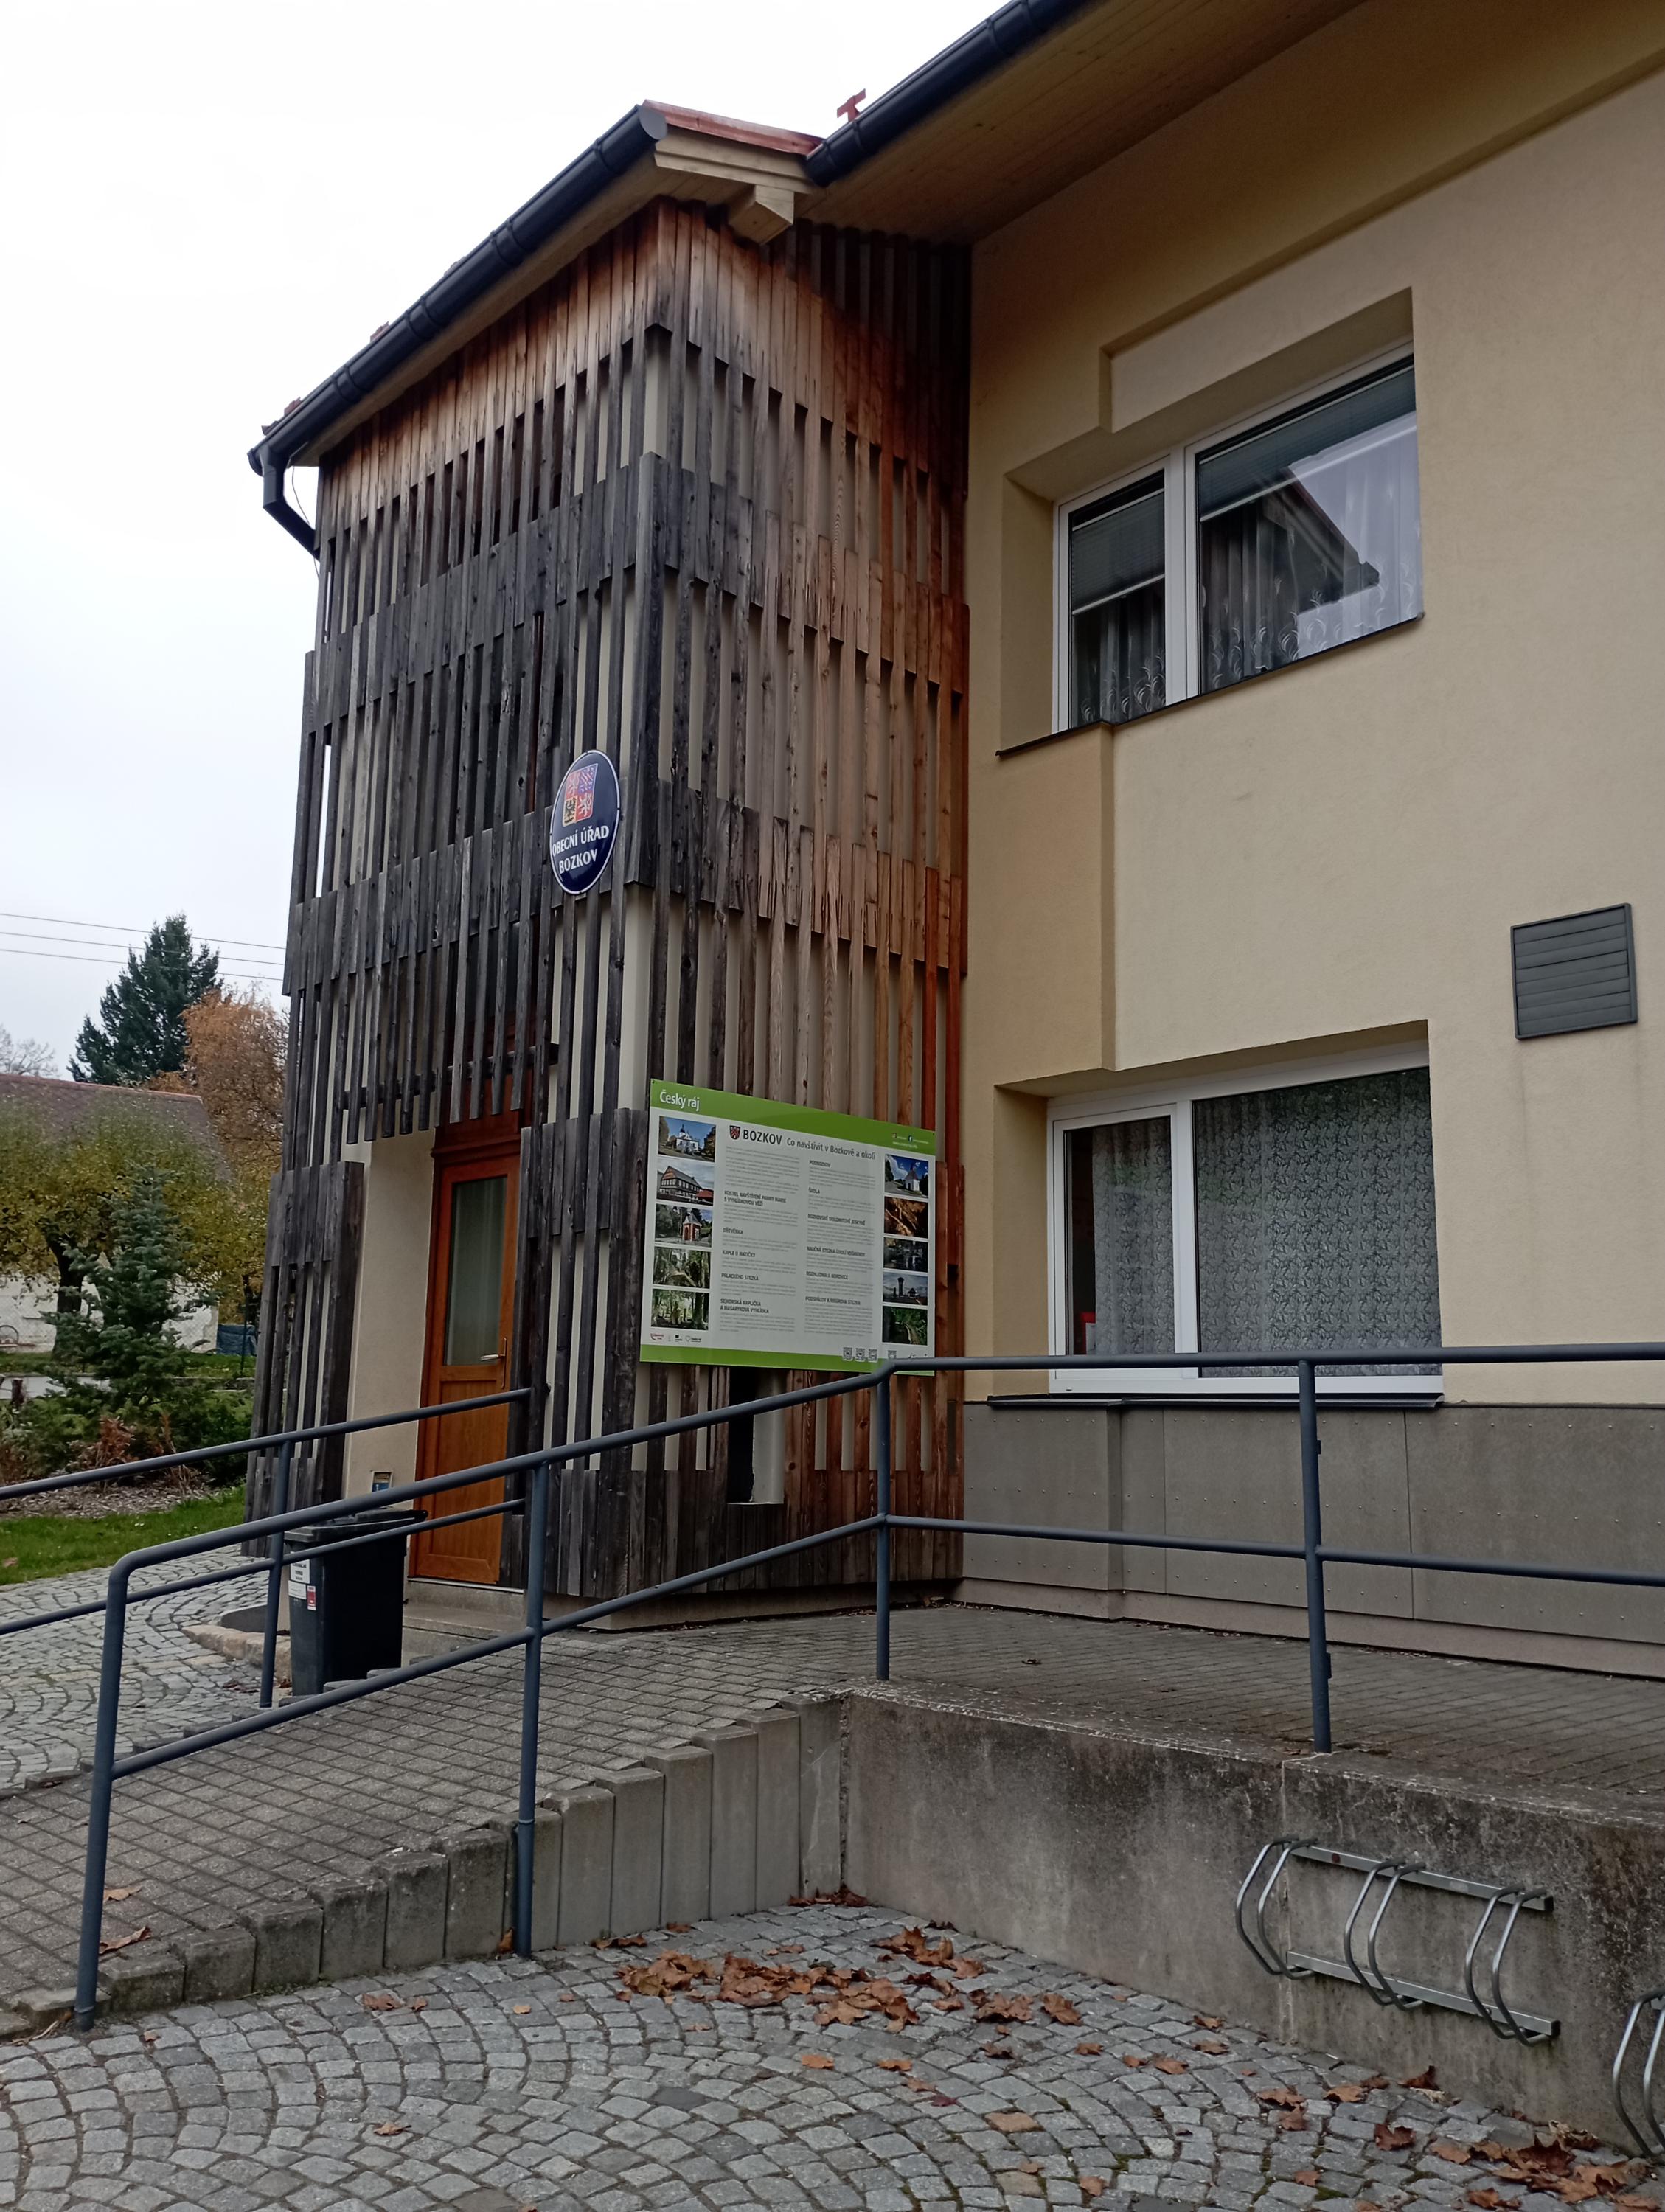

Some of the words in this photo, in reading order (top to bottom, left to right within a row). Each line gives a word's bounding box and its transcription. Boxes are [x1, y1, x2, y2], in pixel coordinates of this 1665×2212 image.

[552, 830, 579, 856] OBECNÍ
[580, 825, 610, 845] ÚŘAD
[559, 849, 598, 874] BOZKOV
[660, 1089, 686, 1109] Český
[687, 1096, 700, 1111] ráj
[743, 1130, 782, 1145] BOZKOV
[787, 1138, 796, 1147] Co
[797, 1140, 824, 1152] navštívit
[830, 1145, 855, 1157] Bozkově
[861, 1151, 876, 1160] okolí
